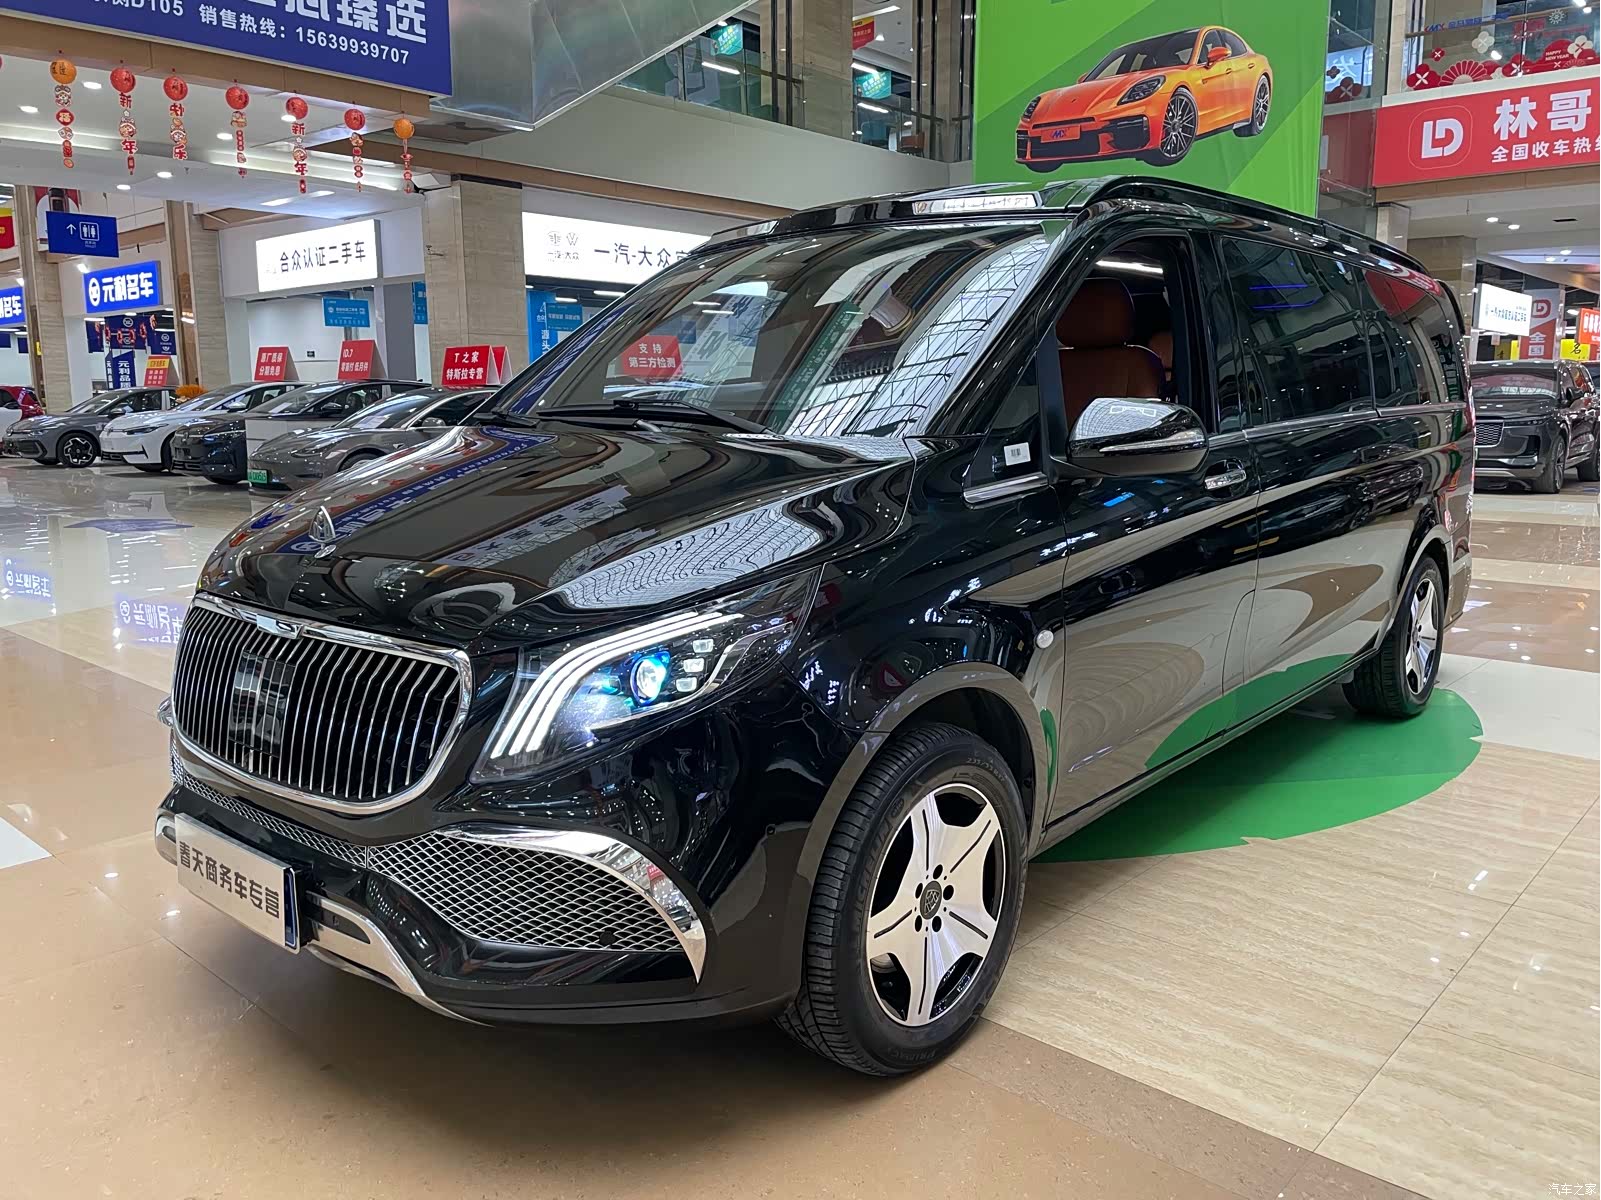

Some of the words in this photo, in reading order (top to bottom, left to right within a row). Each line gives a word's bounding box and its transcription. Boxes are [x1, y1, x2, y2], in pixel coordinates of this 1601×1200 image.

[1493, 89, 1592, 141] 林哥
[280, 240, 366, 273] 合众认证二手车
[102, 272, 154, 303] 元利名车
[638, 343, 662, 354] 支持
[1528, 332, 1547, 360] 全国
[446, 367, 484, 380] 特斯拉专营
[628, 356, 676, 368] 第三方检测
[178, 840, 281, 919] 春天商务车专营
